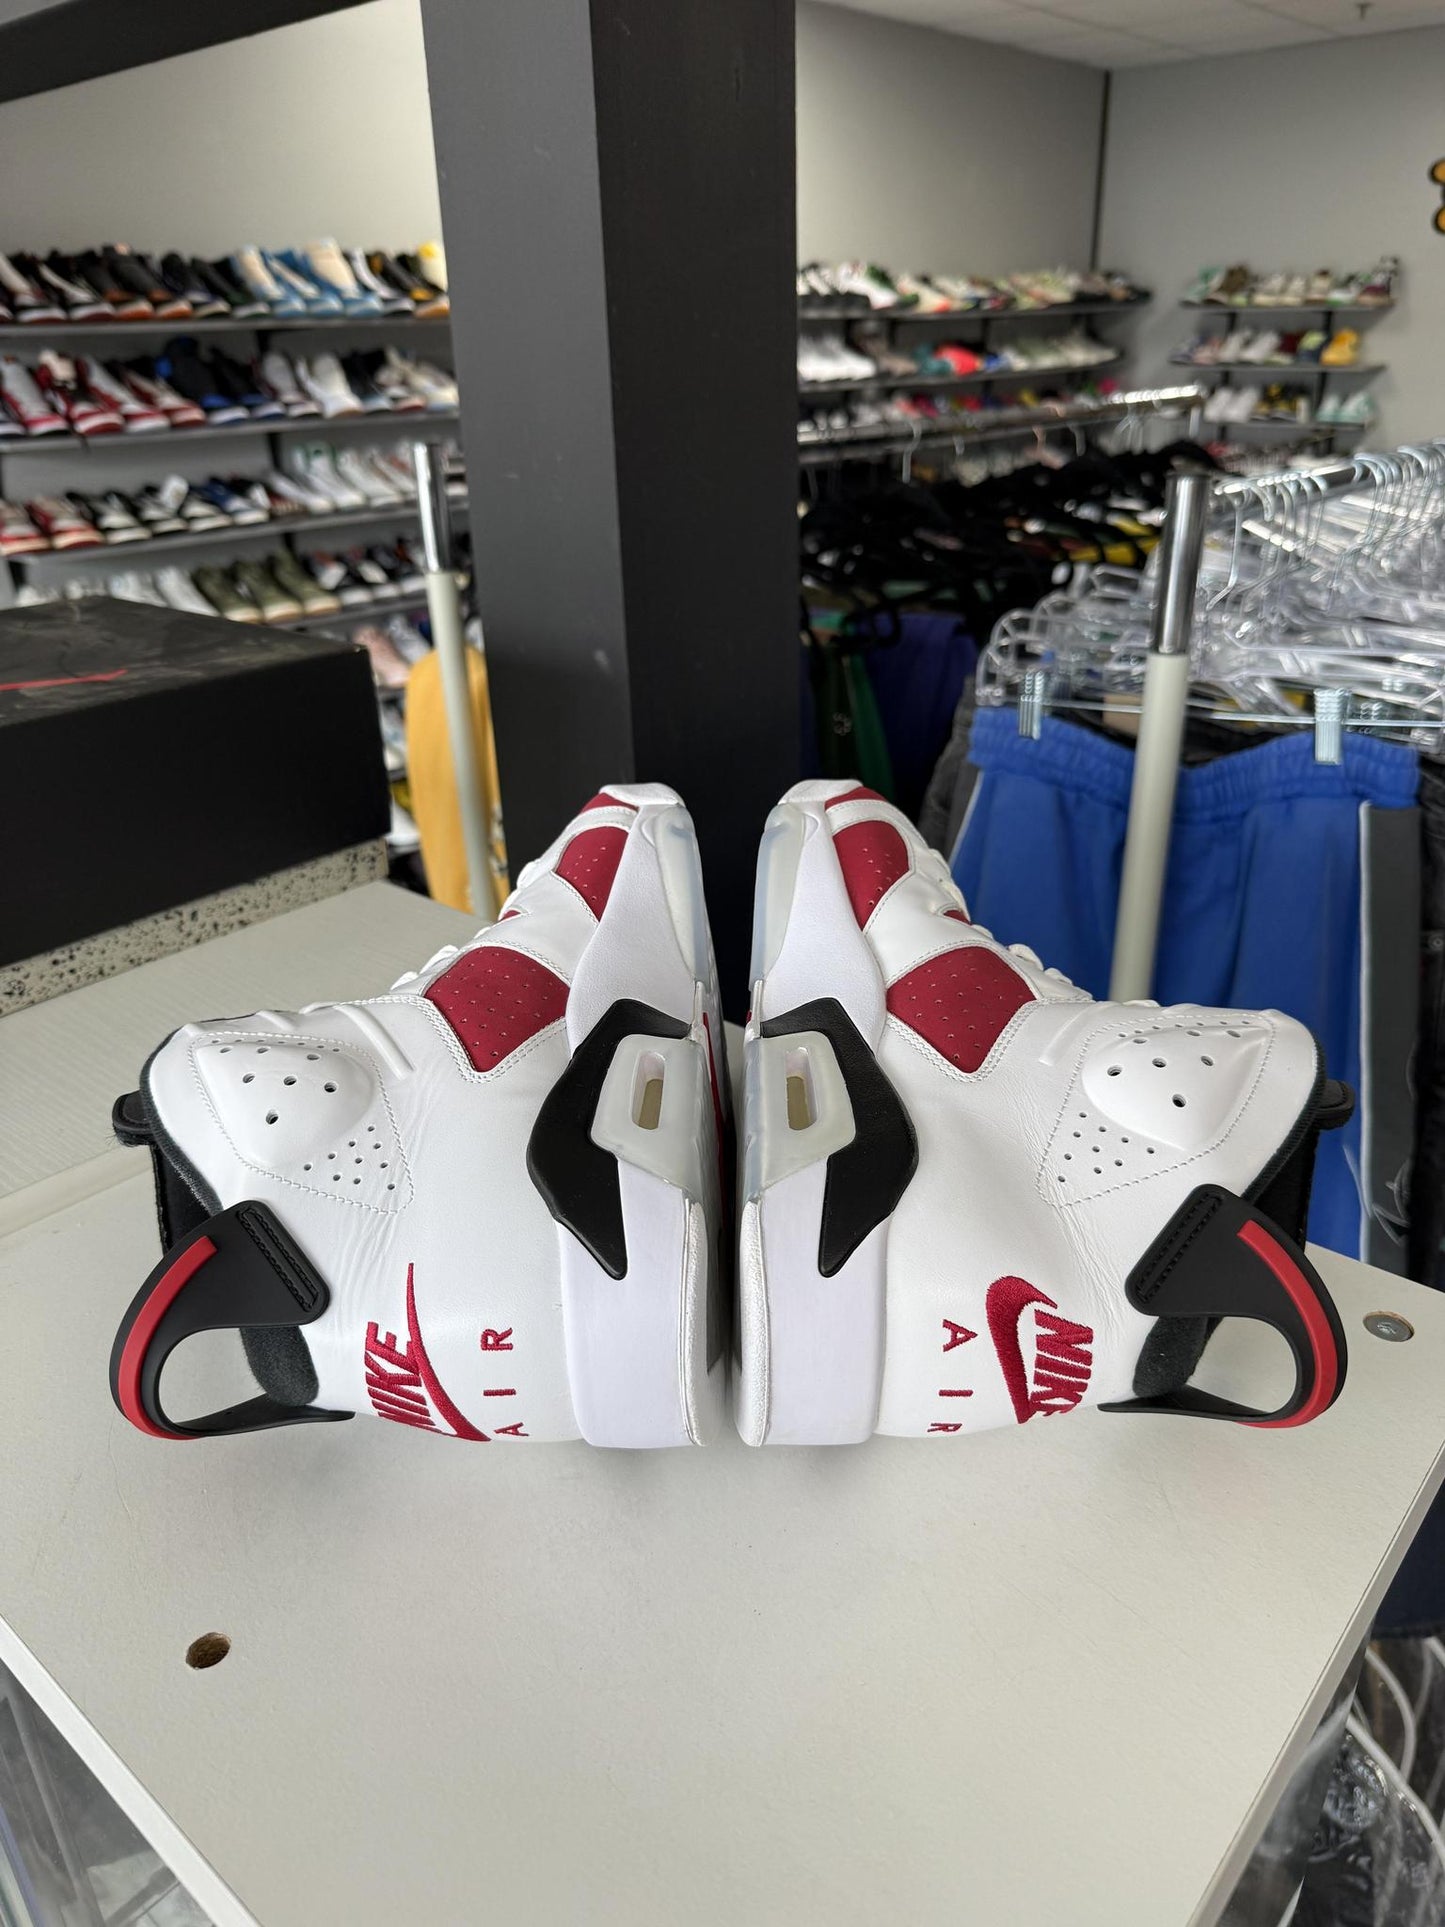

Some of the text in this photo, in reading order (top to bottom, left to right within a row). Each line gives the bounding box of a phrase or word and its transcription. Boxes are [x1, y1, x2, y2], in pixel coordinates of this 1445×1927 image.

[364, 1321, 443, 1435] NIKE
[480, 1327, 530, 1437] AIR
[927, 1318, 979, 1433] AIR
